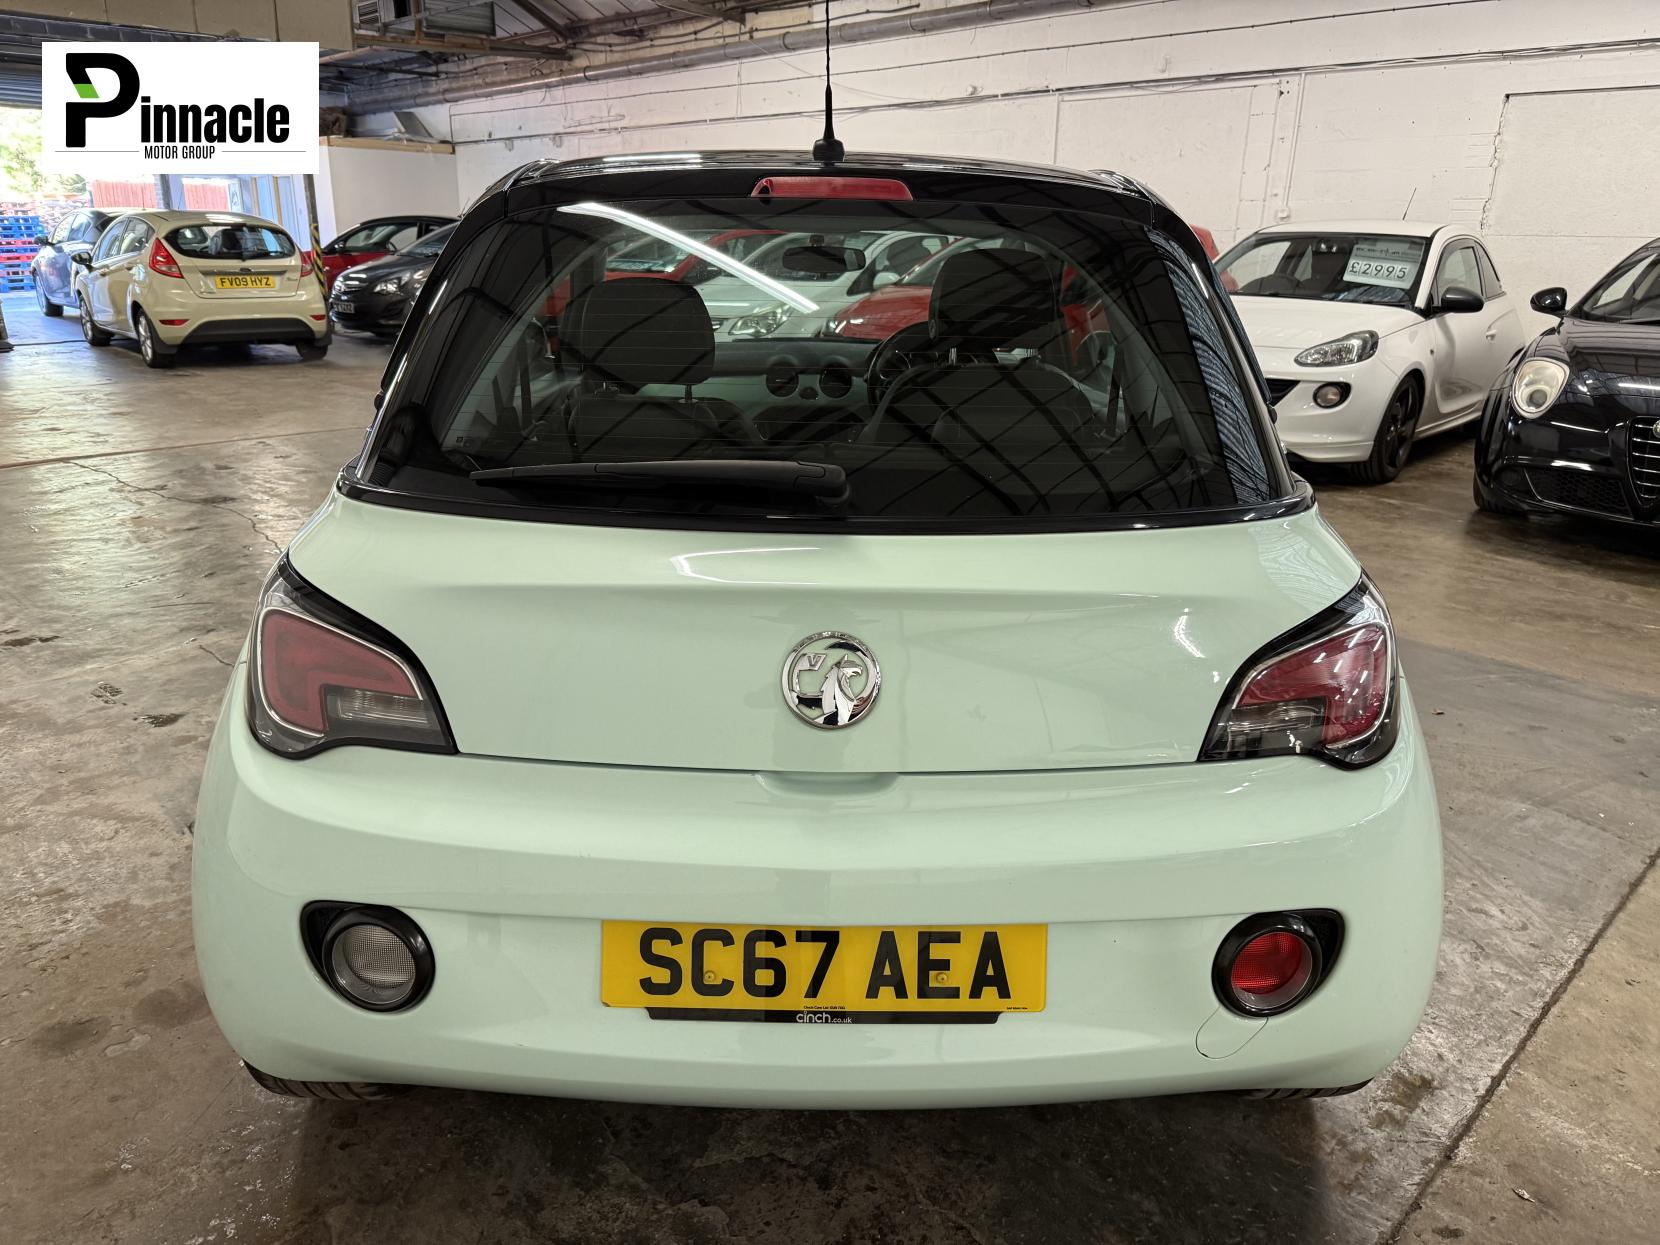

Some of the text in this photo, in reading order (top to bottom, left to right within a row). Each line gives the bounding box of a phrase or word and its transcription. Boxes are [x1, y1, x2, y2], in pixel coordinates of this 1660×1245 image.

[1349, 261, 1408, 279] £2995
[219, 277, 271, 287] FV09 HYZ
[639, 927, 1012, 999] SC67 AEA
[796, 1010, 852, 1023] cinch.co.uk
